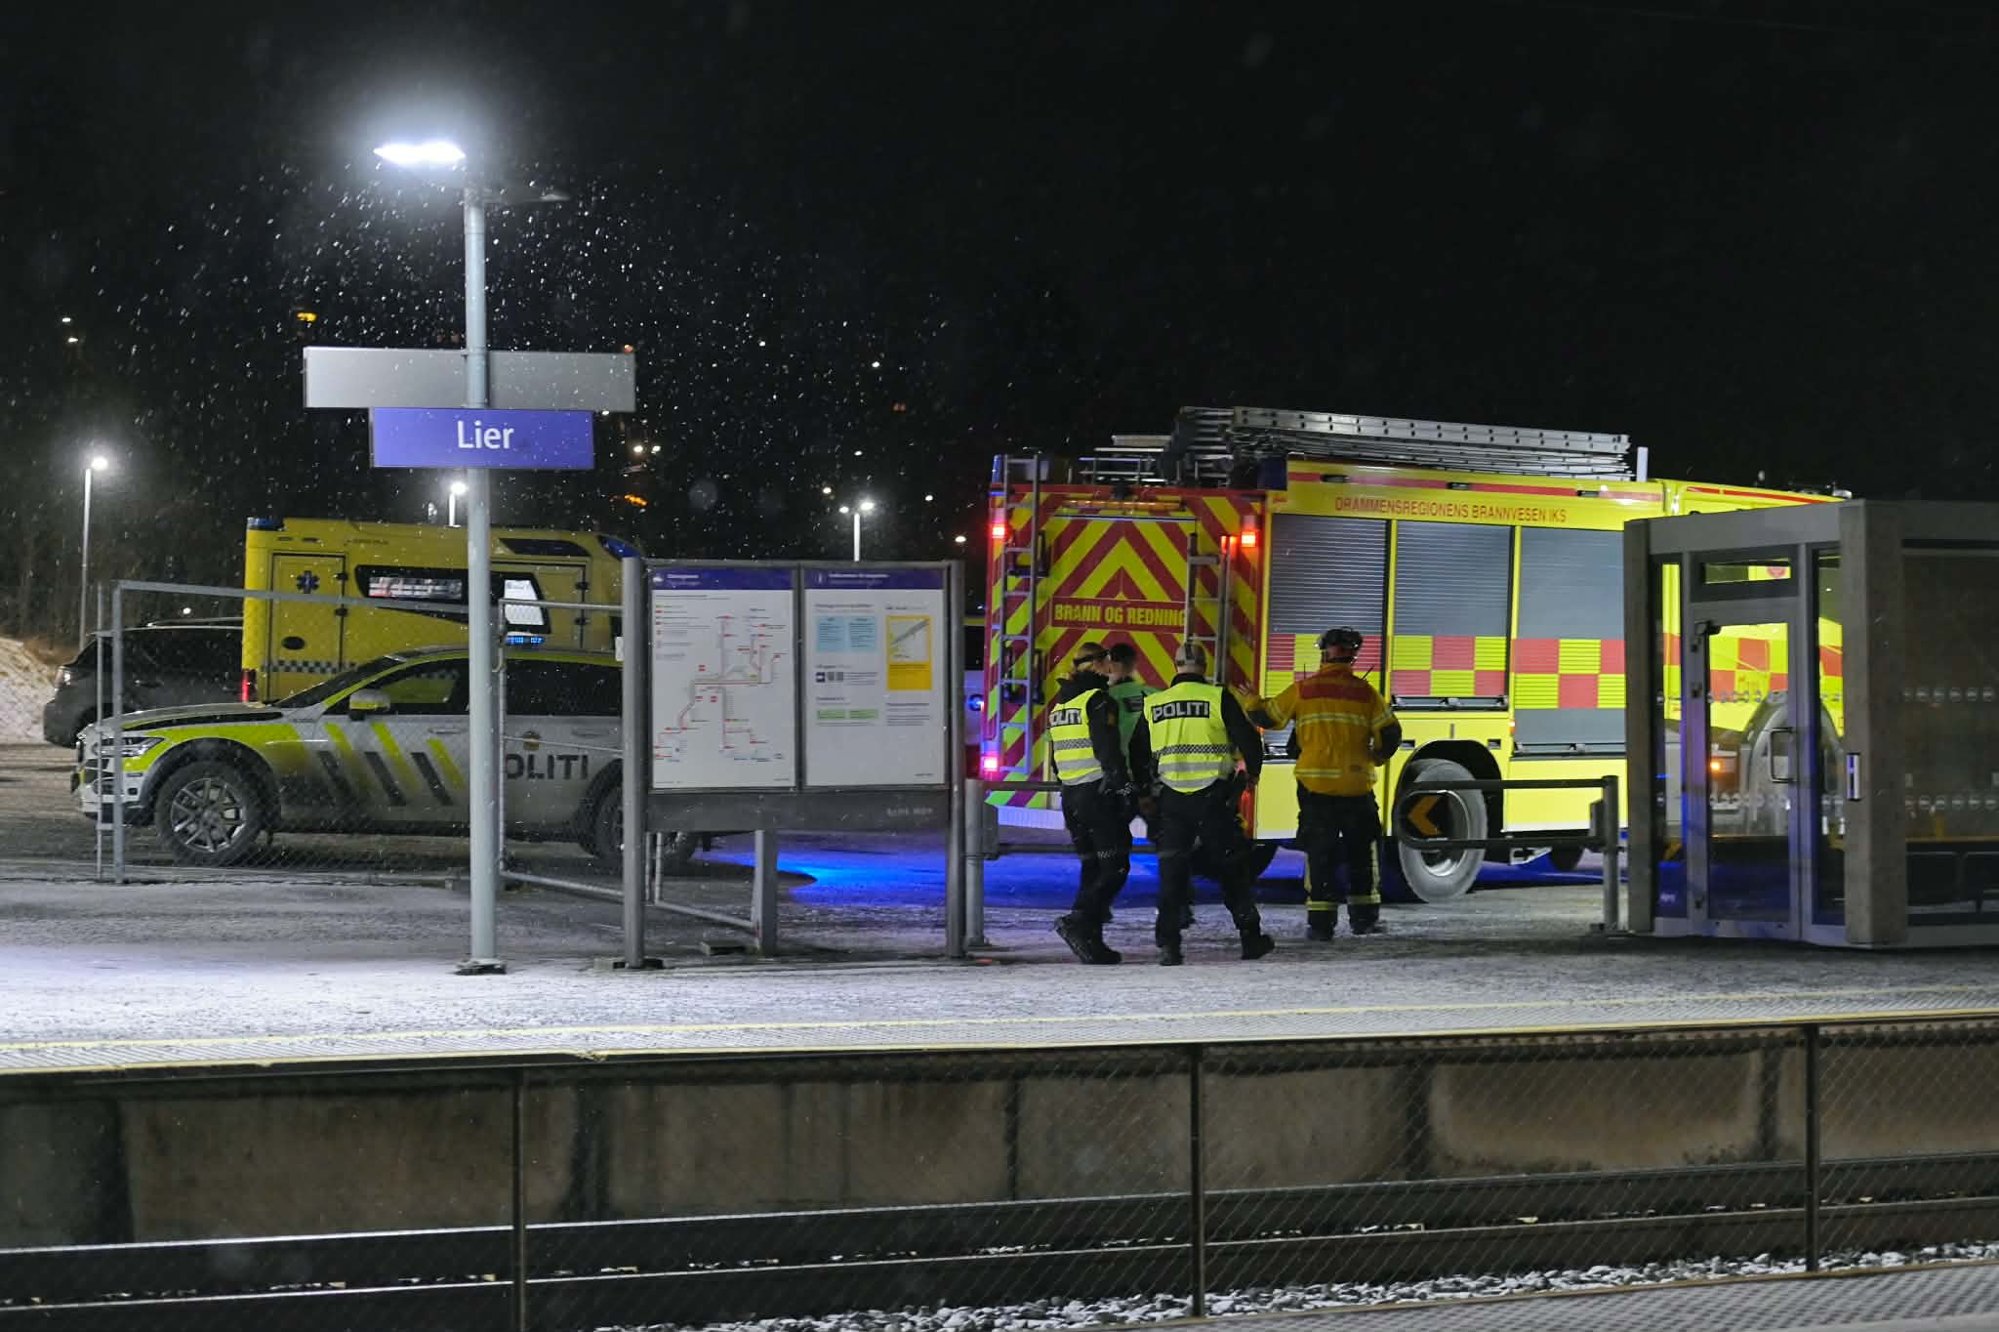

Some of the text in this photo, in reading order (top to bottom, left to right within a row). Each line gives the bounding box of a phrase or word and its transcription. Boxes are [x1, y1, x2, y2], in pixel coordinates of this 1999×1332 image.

[457, 420, 515, 449] Lier
[1335, 496, 1567, 522] DRAMMENSREGIONENS BRANNVESEN IKS
[1054, 603, 1101, 621] BRANN
[1105, 606, 1124, 623] OG
[1153, 702, 1209, 721] POLITI
[505, 753, 589, 779] OLITI
